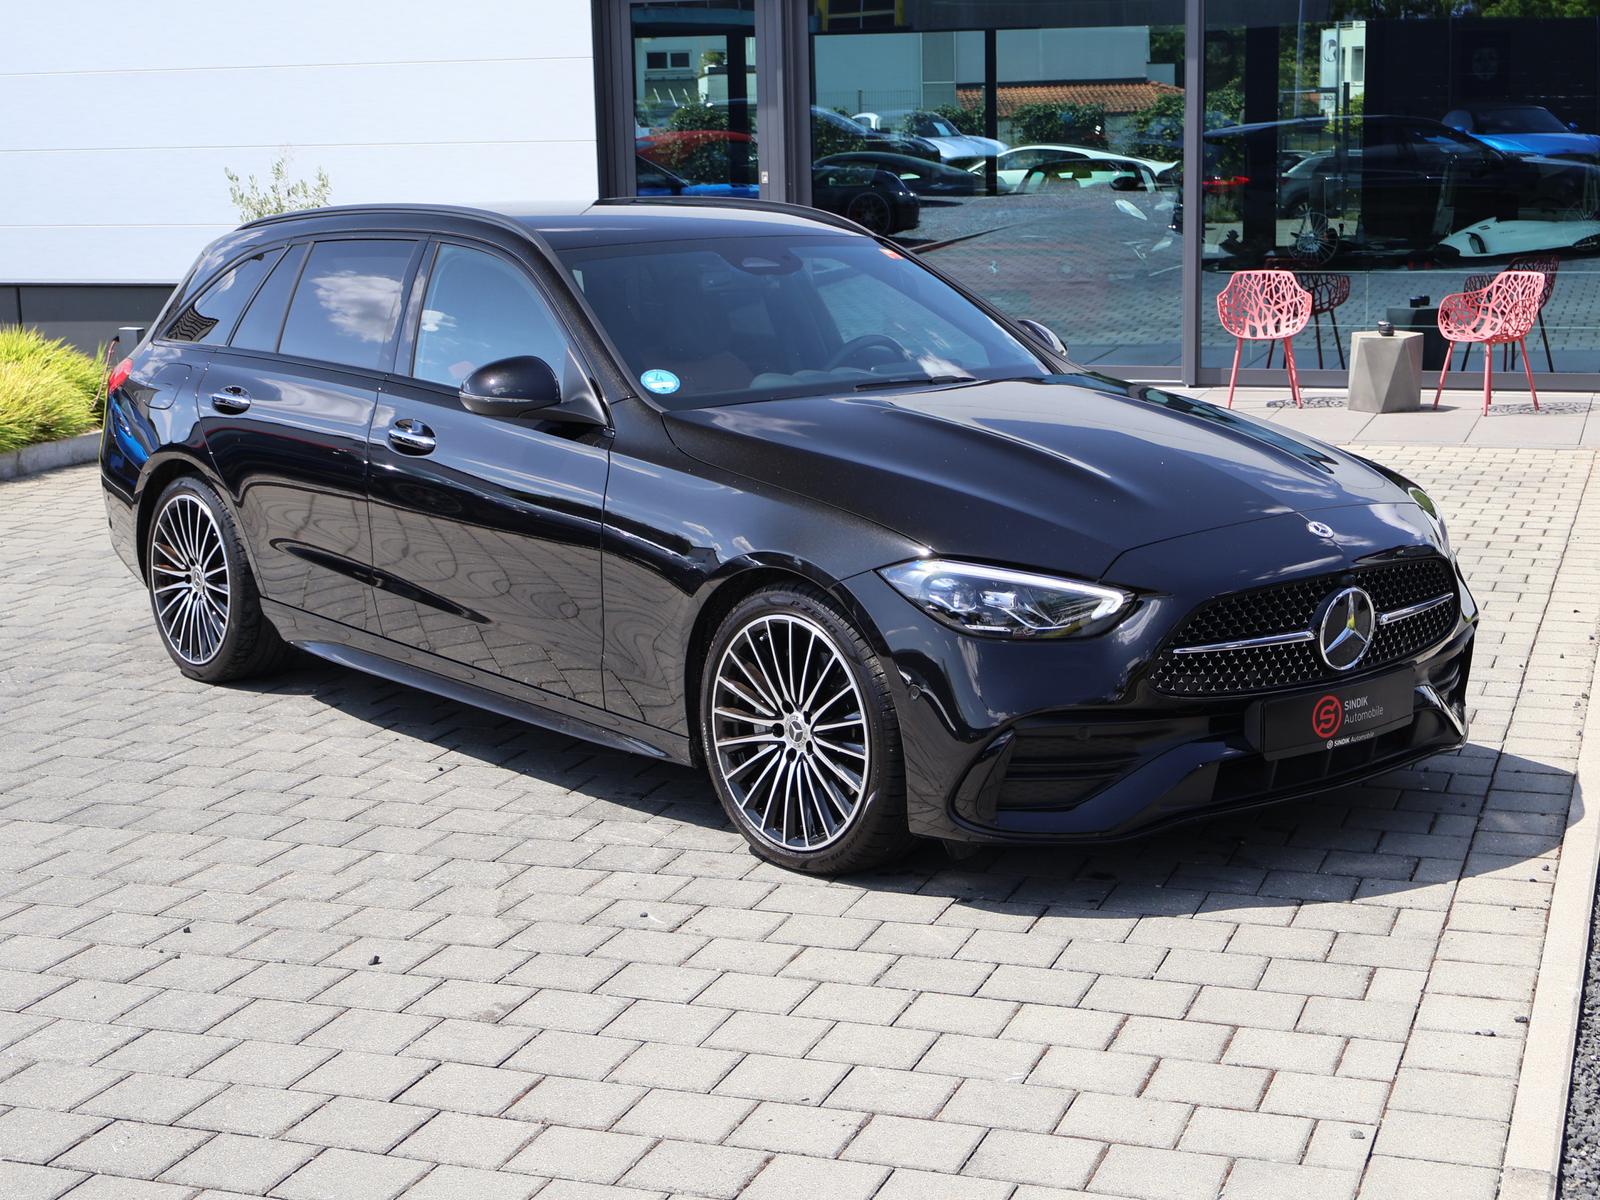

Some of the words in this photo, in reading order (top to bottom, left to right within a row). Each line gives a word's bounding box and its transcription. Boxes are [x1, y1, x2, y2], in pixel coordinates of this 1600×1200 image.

[1344, 696, 1368, 711] SINDIK
[1344, 705, 1384, 725] Automobile
[1334, 737, 1350, 746] SINDIK
[1351, 731, 1375, 742] Automobile
